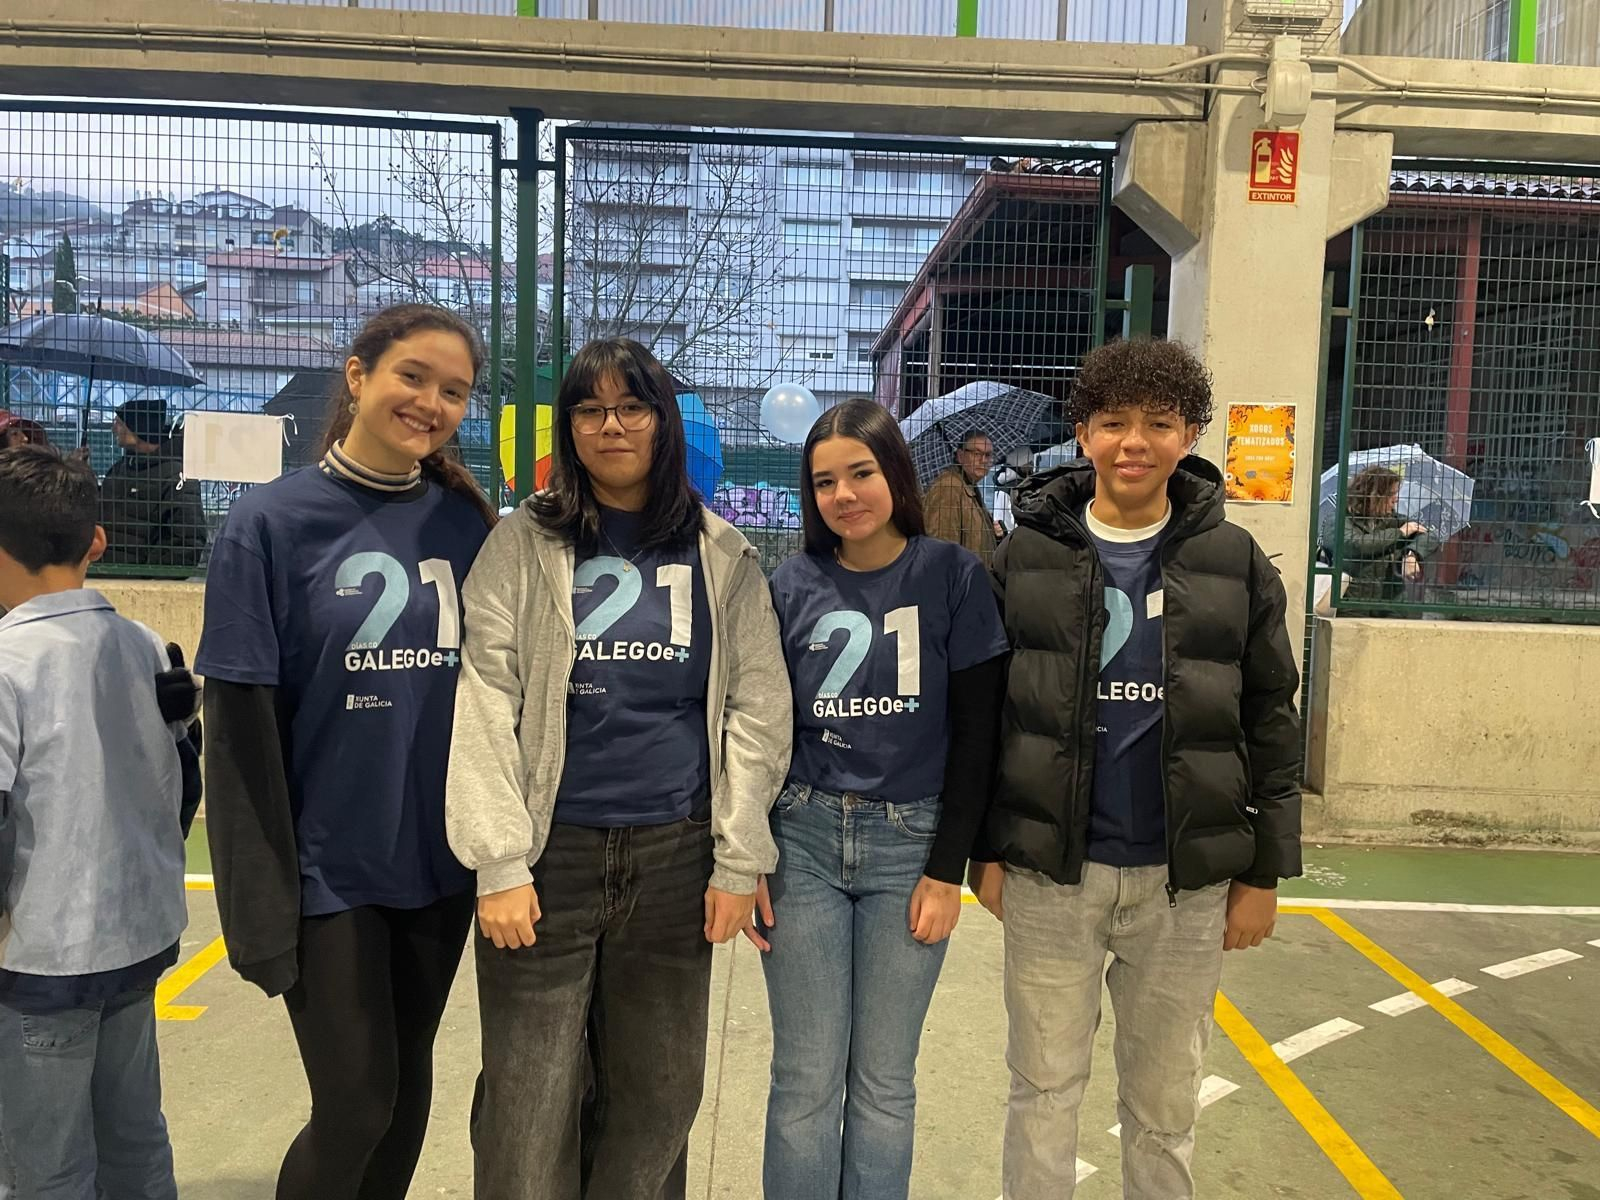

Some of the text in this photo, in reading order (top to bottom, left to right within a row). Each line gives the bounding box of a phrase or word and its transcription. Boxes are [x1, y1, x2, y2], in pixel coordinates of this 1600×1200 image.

[1252, 192, 1291, 201] EXTINTOR
[1236, 436, 1285, 446] TEMATIZADOS
[334, 551, 460, 651] 21
[573, 555, 693, 648] 21
[574, 641, 689, 662] ALEGOe+
[808, 605, 920, 699] 21
[579, 687, 607, 695] GALICIA
[364, 700, 392, 708] GALICIA
